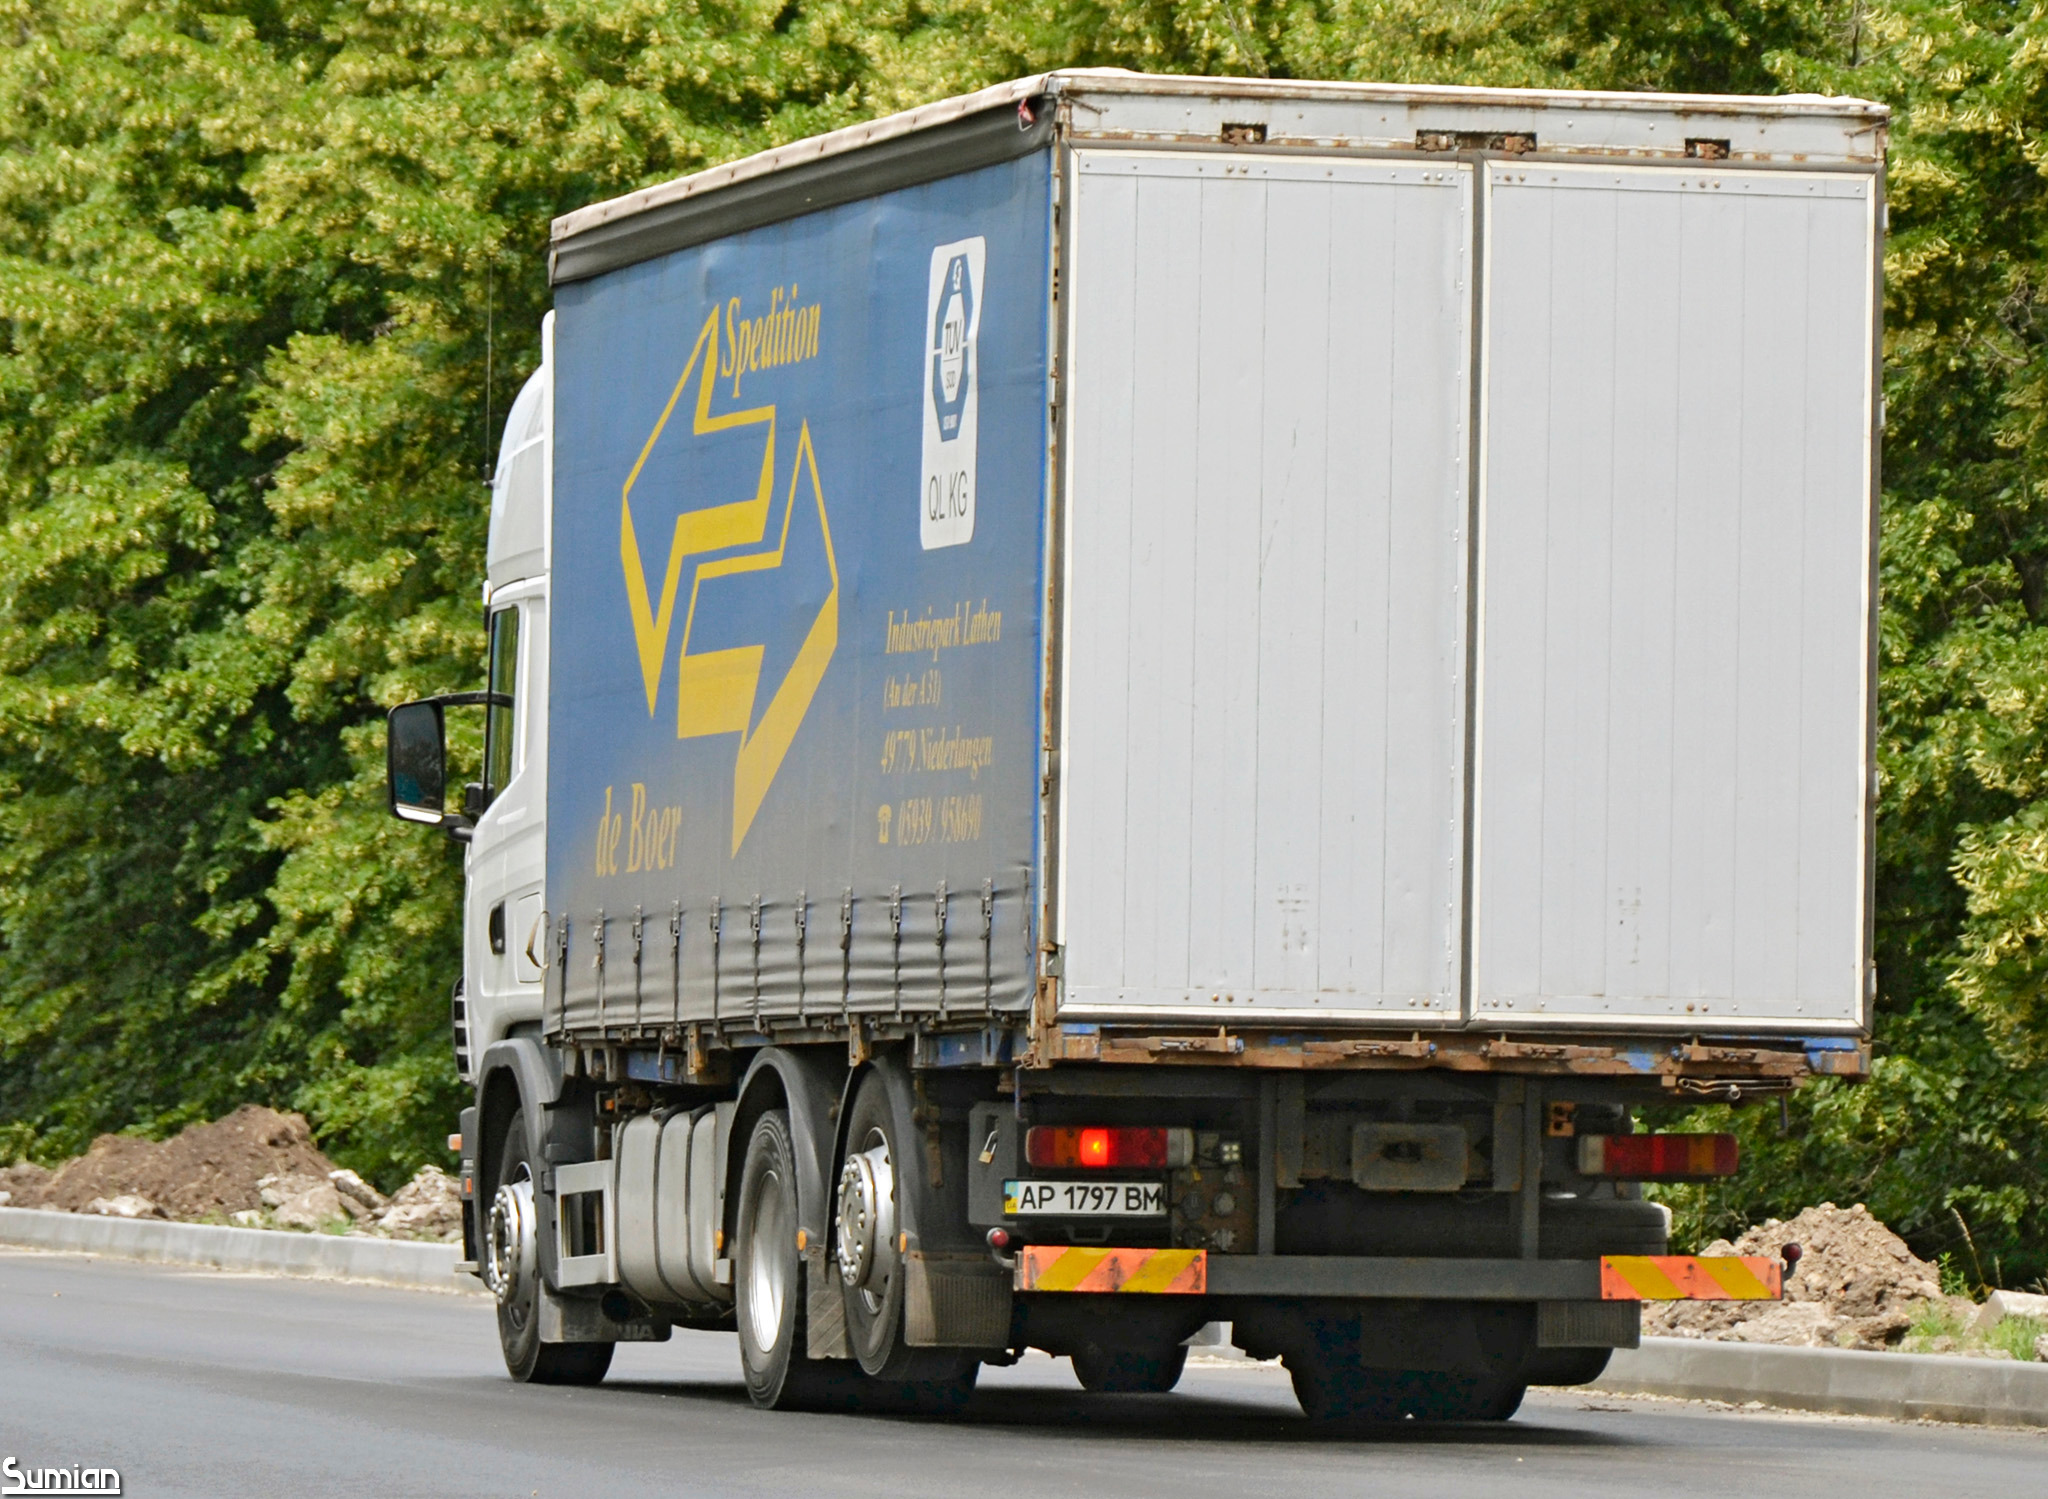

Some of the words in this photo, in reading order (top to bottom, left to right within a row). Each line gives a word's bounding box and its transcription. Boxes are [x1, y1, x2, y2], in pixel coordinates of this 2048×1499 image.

[721, 282, 821, 398] Spedition
[929, 474, 946, 522] QL
[949, 470, 968, 517] KG
[885, 602, 961, 662] Industriepark
[963, 598, 1002, 646] Lathen
[902, 673, 918, 707] der
[918, 725, 993, 780] Niederlangen
[595, 784, 622, 877] de
[625, 782, 682, 872] Boer
[1020, 1186, 1056, 1210] AP
[1064, 1186, 1119, 1211] 1797
[1125, 1187, 1162, 1211] BM
